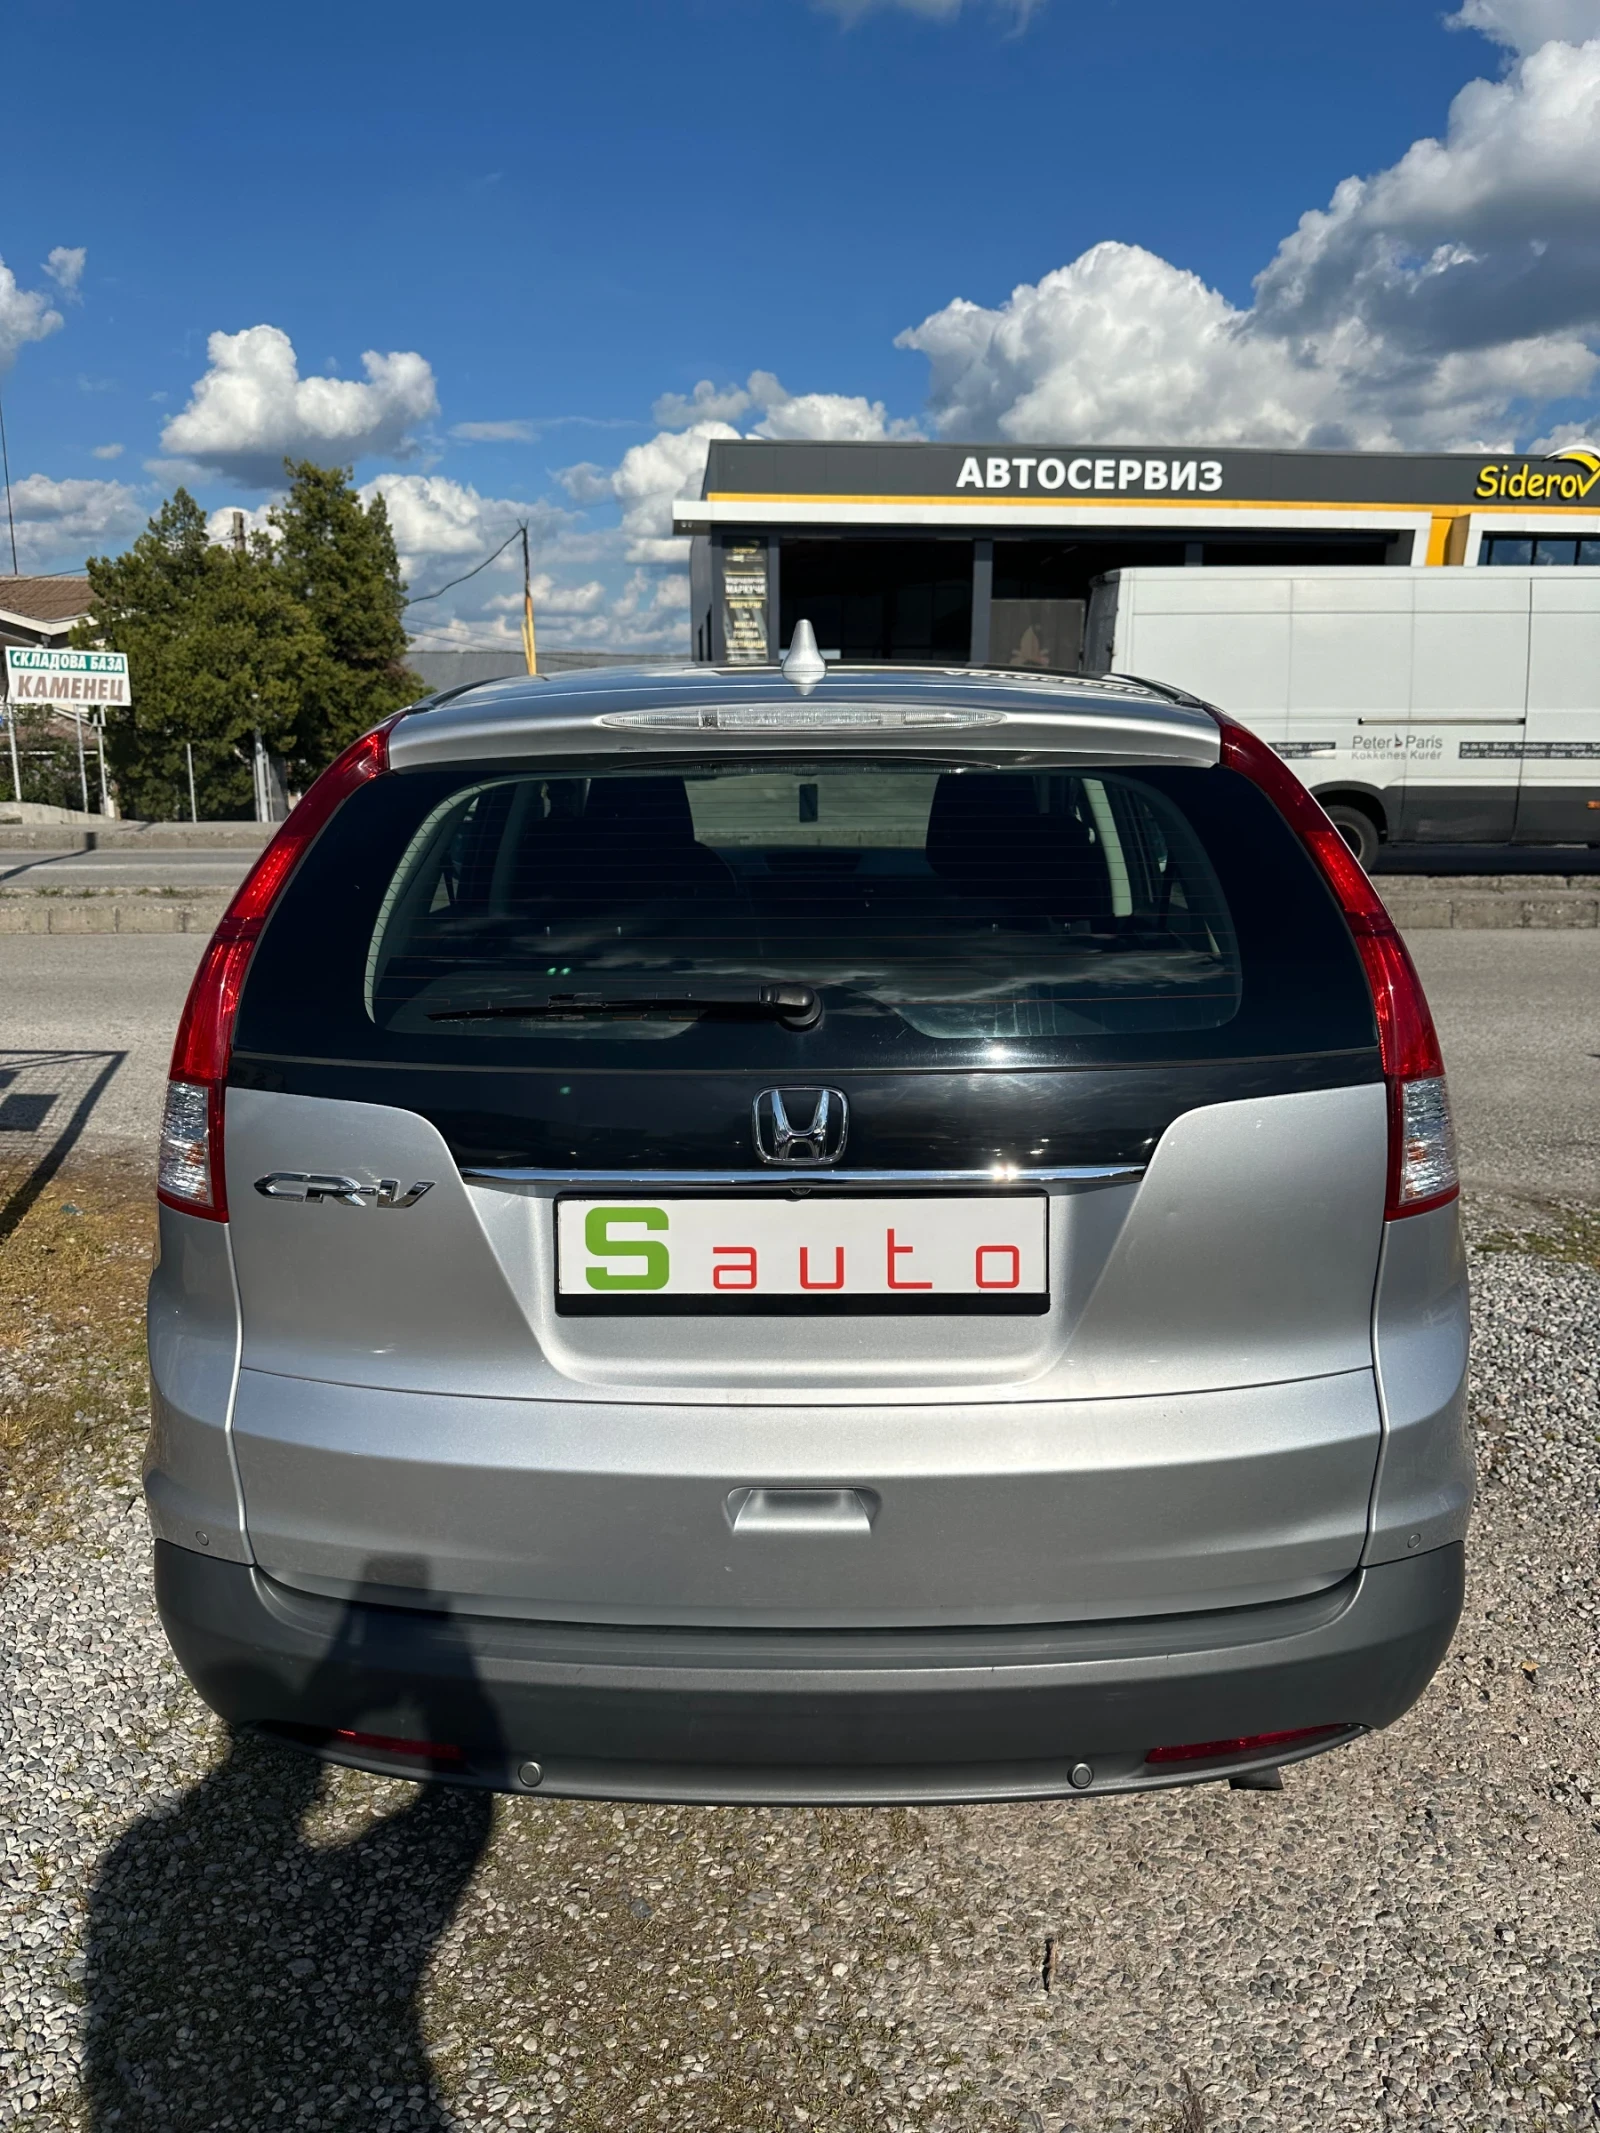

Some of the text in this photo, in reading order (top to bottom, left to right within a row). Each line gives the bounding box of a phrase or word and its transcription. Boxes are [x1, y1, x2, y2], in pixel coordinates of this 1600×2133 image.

[956, 457, 1223, 492] АВТОСЕРВИЗ
[1476, 463, 1600, 498] Siderov
[12, 651, 123, 671] СКЛАДОВА БАЗА
[17, 675, 124, 702] КАМЕНЕЦ
[1352, 734, 1443, 749] Peter Paris
[1410, 750, 1442, 760] Kurér
[254, 1171, 436, 1209] CR-V
[585, 1207, 1020, 1291] S auto
